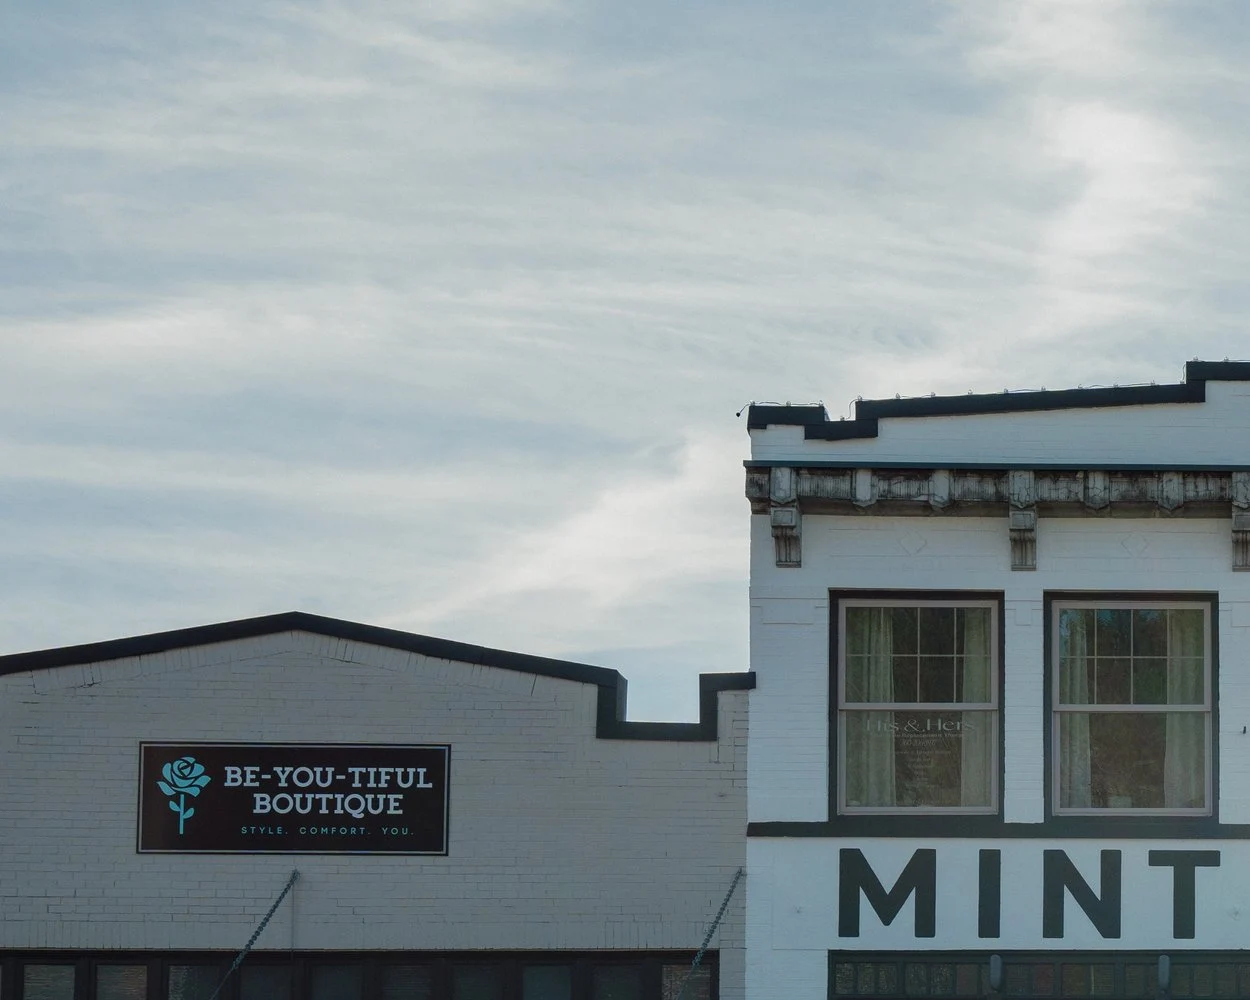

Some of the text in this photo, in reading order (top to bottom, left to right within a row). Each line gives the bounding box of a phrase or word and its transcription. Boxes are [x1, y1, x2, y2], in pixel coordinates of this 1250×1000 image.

[904, 718, 925, 732] &
[926, 718, 976, 732] Hers
[223, 765, 433, 789] BE-YOU-TIFUL
[252, 792, 404, 819] BOUTIQUE
[240, 826, 415, 836] STYLE. COMFORT. YOU.
[838, 848, 1221, 940] MINT
